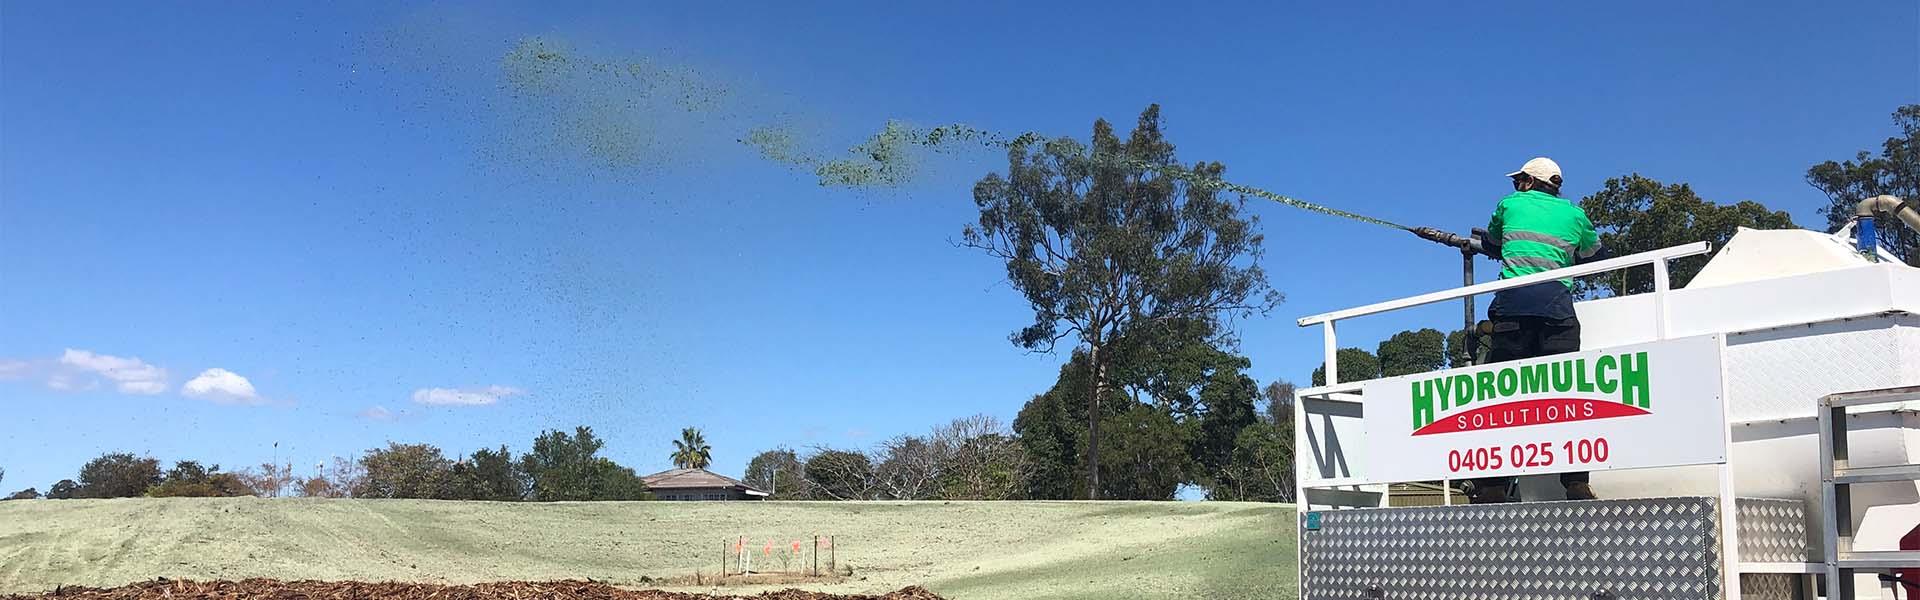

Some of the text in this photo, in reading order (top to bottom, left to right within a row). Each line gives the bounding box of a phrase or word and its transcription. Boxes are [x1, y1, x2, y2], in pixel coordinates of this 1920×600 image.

[1411, 351, 1650, 431] HYDROMULCH
[1457, 401, 1594, 430] SOLUTIONS
[1448, 437, 1608, 472] 0405 025 100
